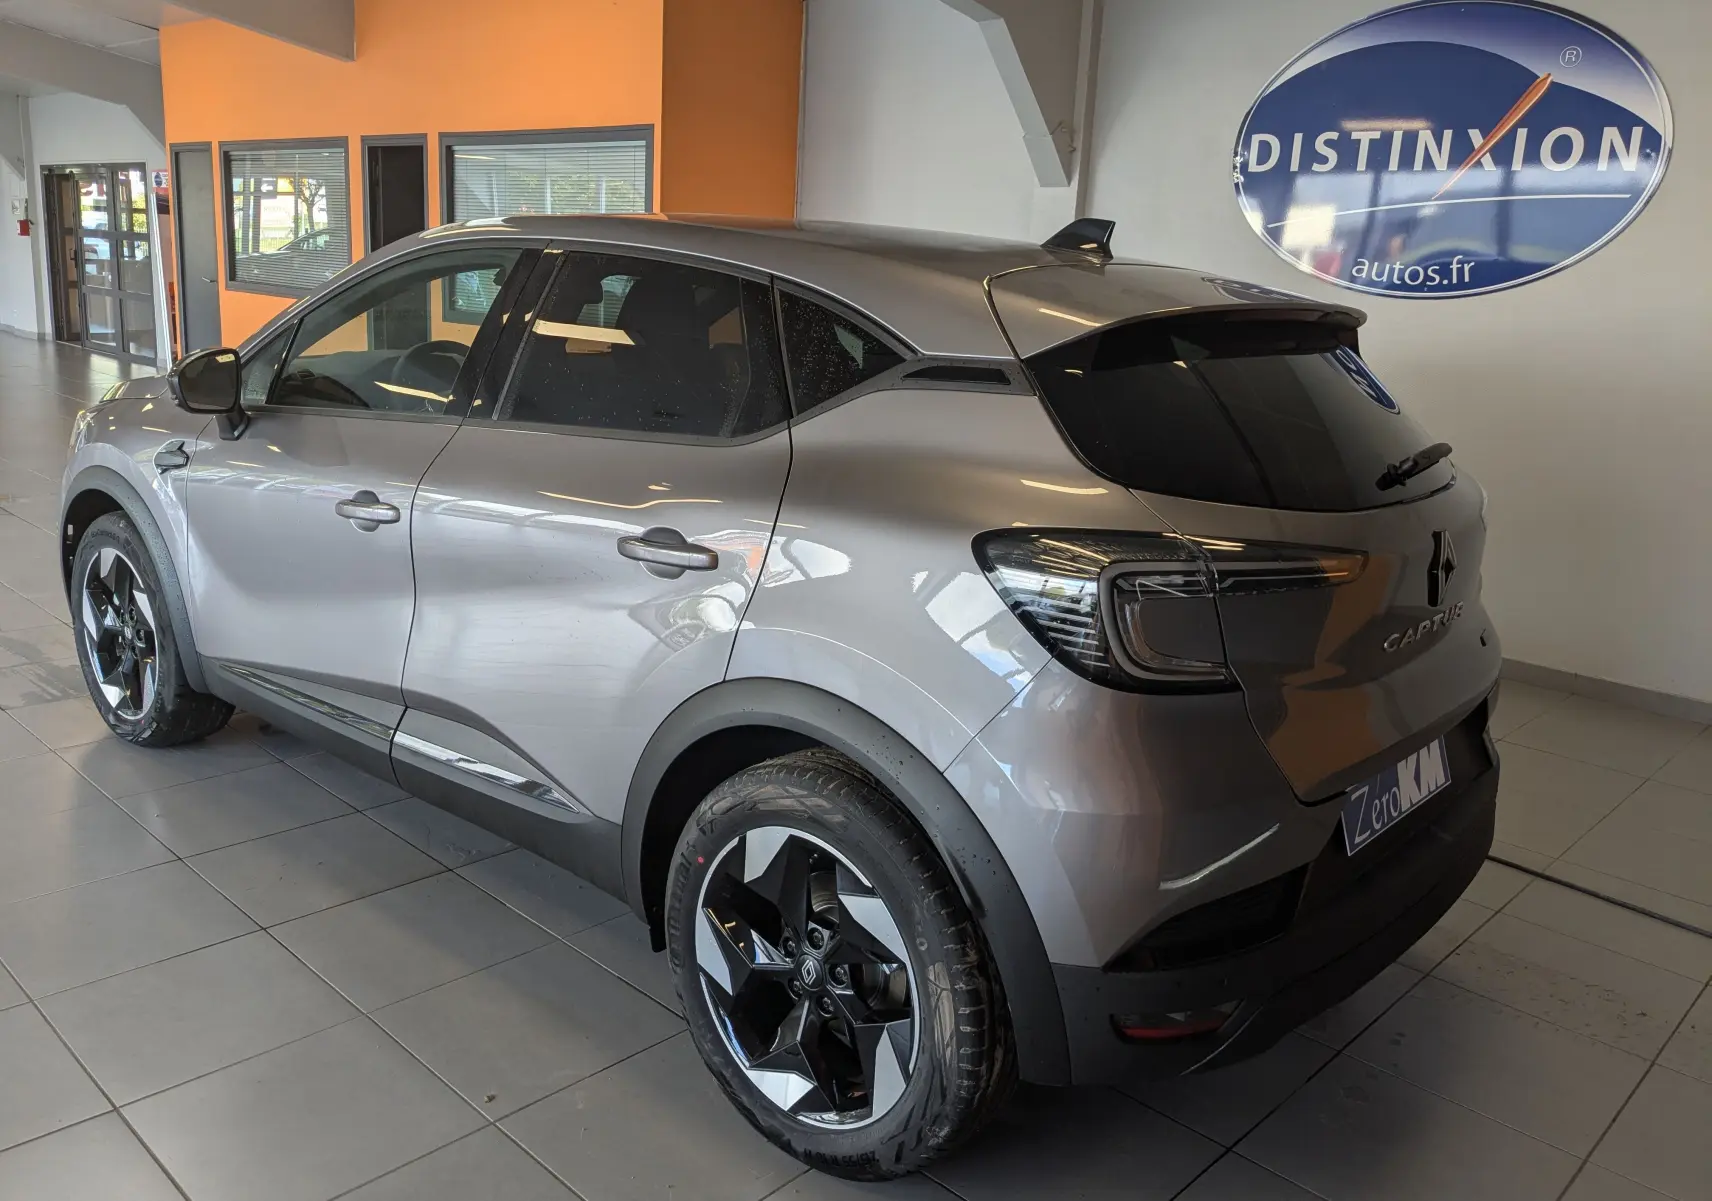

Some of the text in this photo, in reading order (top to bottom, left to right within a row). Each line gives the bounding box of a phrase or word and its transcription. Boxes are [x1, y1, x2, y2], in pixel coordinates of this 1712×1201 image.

[1247, 126, 1644, 173] DISTINXION
[1351, 256, 1475, 286] autos.fr
[1382, 601, 1464, 653] CAPTUR
